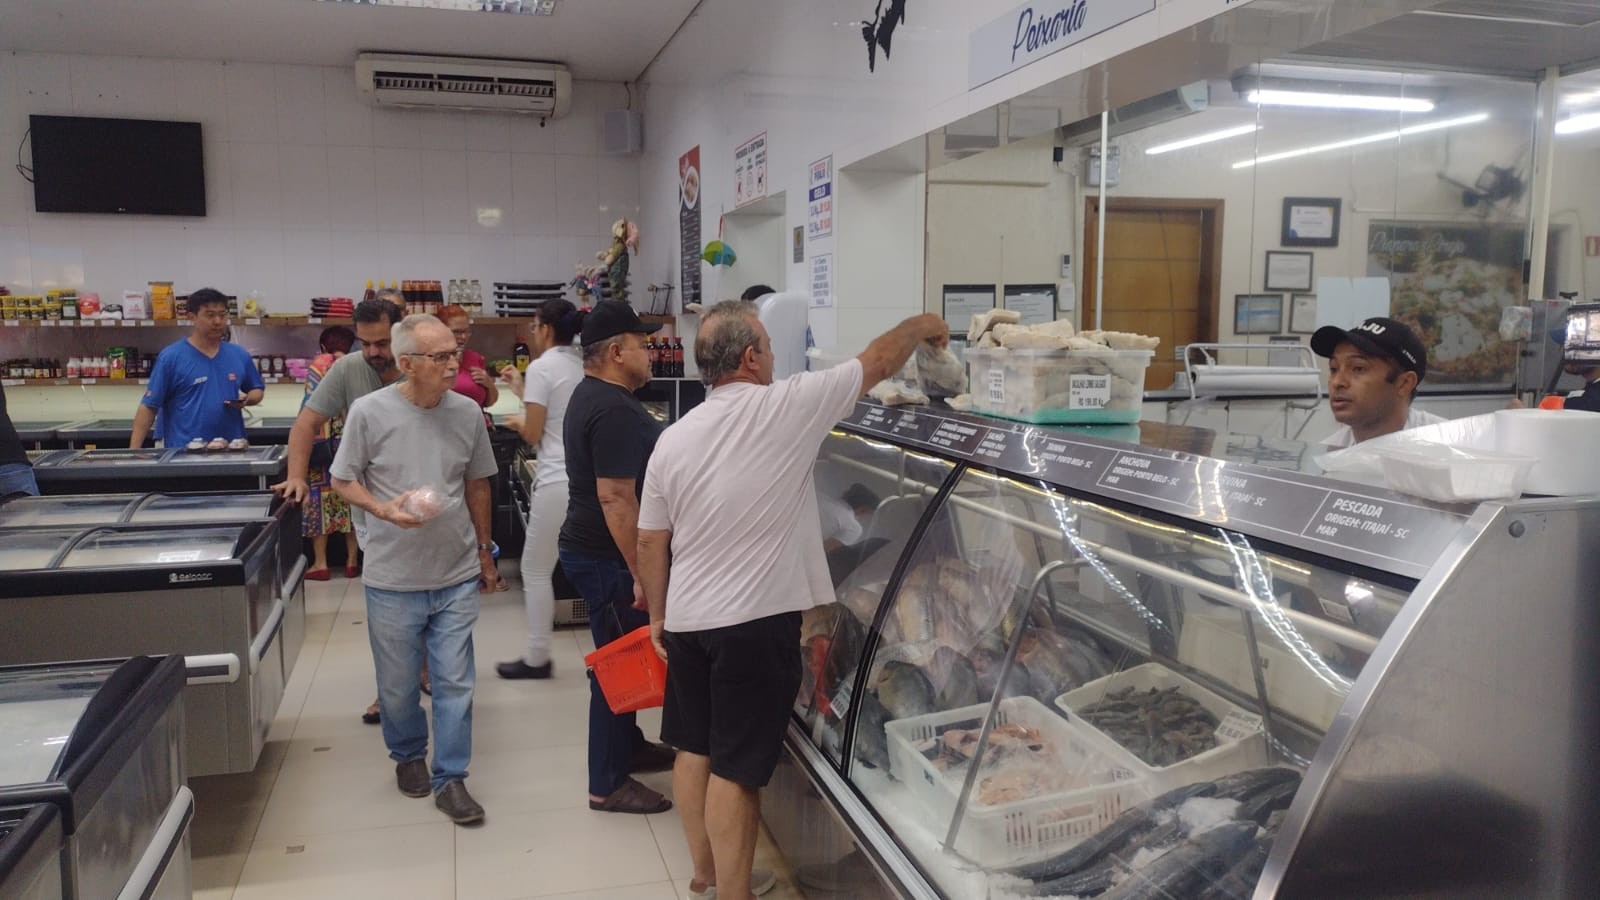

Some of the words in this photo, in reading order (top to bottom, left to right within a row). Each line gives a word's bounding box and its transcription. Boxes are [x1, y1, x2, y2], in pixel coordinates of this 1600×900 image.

[1011, 0, 1087, 63] Peixaria
[1254, 496, 1268, 507] SC
[1332, 498, 1384, 518] PESCADA
[1315, 524, 1339, 537] MAR
[1324, 512, 1361, 528] ORIGEM:
[1360, 520, 1392, 535] ITAJAÍ
[1394, 527, 1410, 539] SC
